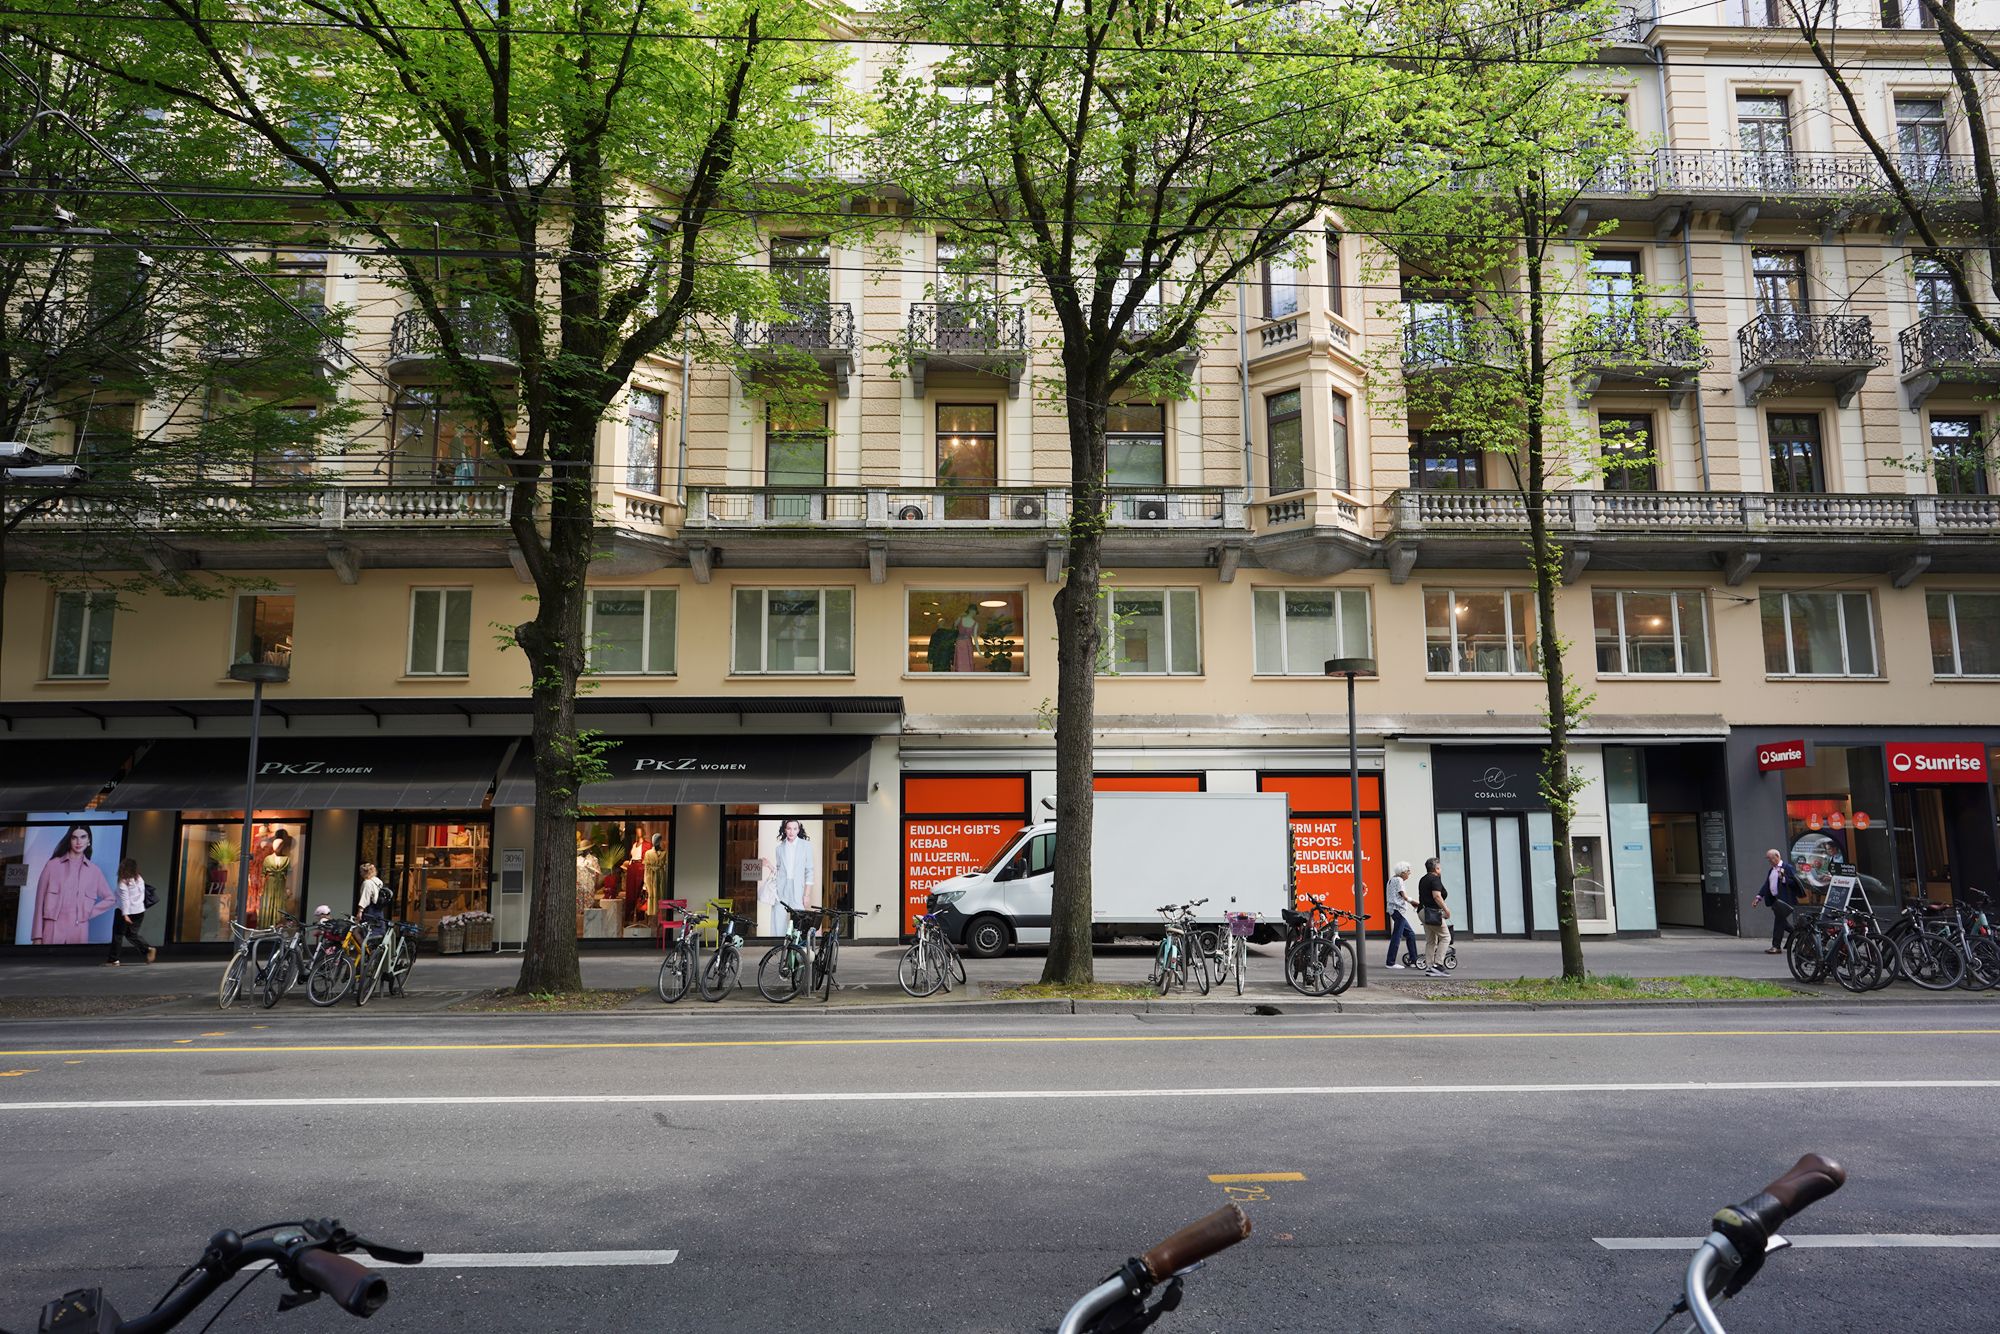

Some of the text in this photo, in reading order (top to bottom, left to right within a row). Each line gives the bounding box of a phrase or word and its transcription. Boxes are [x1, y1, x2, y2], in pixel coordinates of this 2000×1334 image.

[1115, 603, 1139, 612] PKZ
[1770, 748, 1802, 763] Sunrise
[632, 758, 698, 771] PKZ
[1914, 753, 1981, 771] Sunrise
[256, 761, 326, 775] PKZ
[910, 824, 1001, 835] ENDLICH GIBT'S
[1314, 823, 1337, 833] HAT
[910, 838, 948, 849] KEBAB
[1294, 836, 1342, 847] TSPOTS:
[504, 854, 522, 863] 30%
[910, 852, 979, 862] IN LUZERN...
[1296, 850, 1371, 861] ENDENKML,
[743, 863, 761, 872] 30%
[910, 866, 982, 876] MACHT EUC
[1295, 861, 1355, 873] PELBRÜCK
